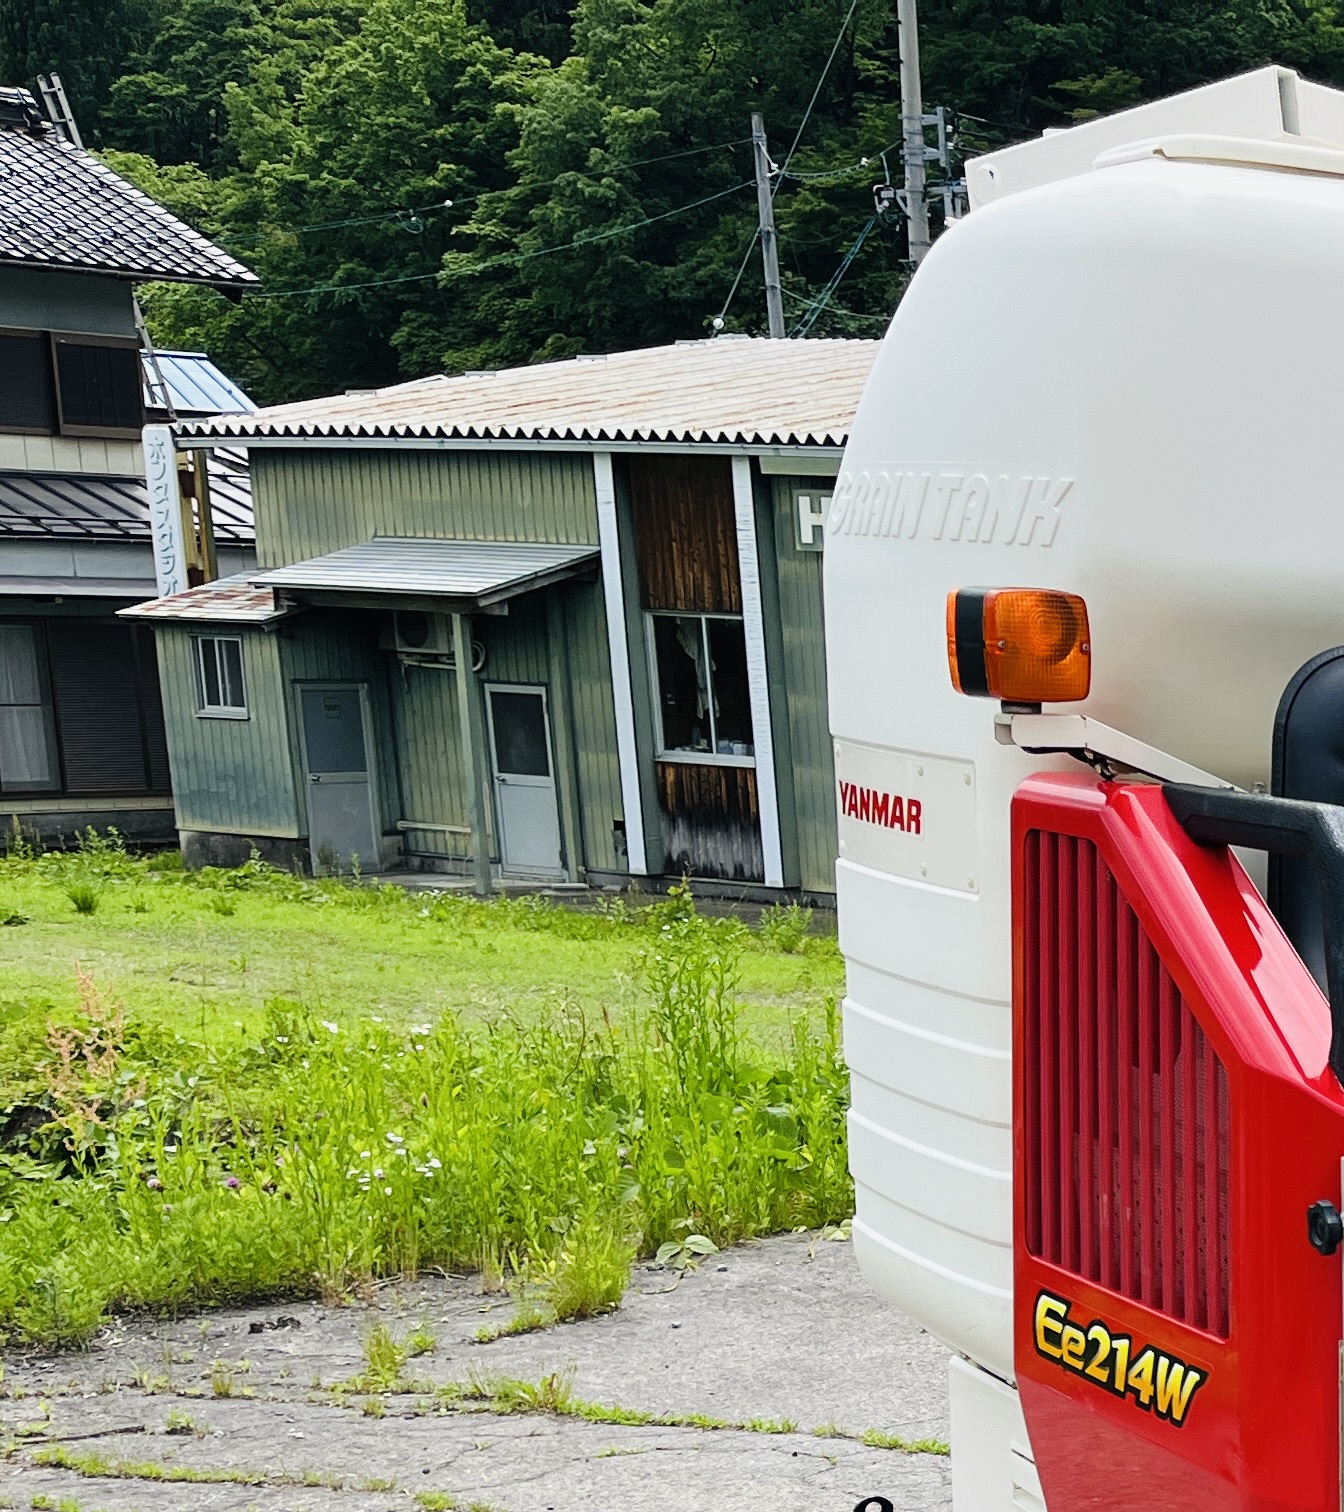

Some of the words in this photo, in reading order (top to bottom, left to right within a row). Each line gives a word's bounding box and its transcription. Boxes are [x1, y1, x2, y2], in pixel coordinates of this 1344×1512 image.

[932, 473, 1075, 547] TANK
[839, 779, 922, 835] YANMAR
[1035, 1291, 1205, 1425] Ee214W
